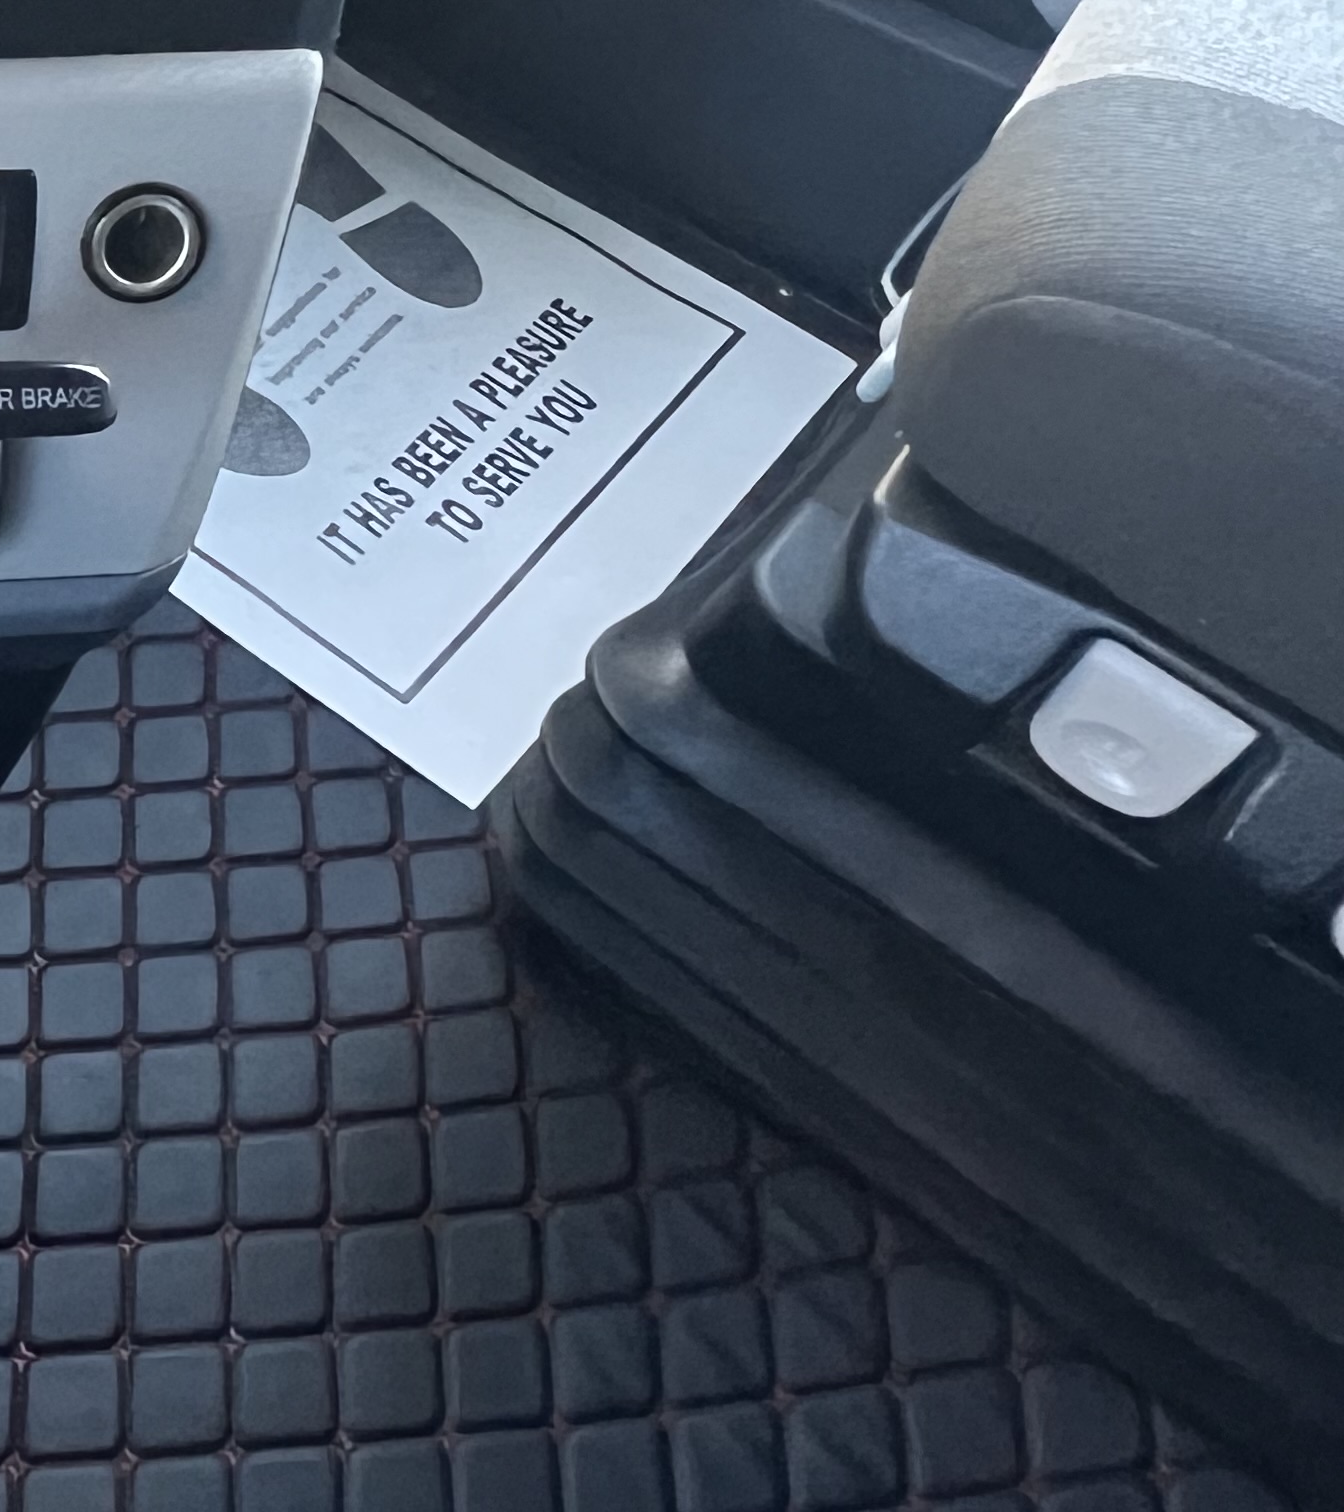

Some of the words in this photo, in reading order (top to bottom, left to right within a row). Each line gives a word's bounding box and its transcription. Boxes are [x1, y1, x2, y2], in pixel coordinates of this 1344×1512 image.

[468, 297, 594, 411] PLEASURE
[20, 386, 103, 410] BRAKE
[452, 399, 496, 433] A
[391, 416, 475, 489] BEEN
[425, 499, 483, 543] TO
[462, 426, 554, 508] SERVE
[525, 379, 597, 436] YOU
[342, 477, 415, 539] HAS
[316, 522, 365, 566] IT
